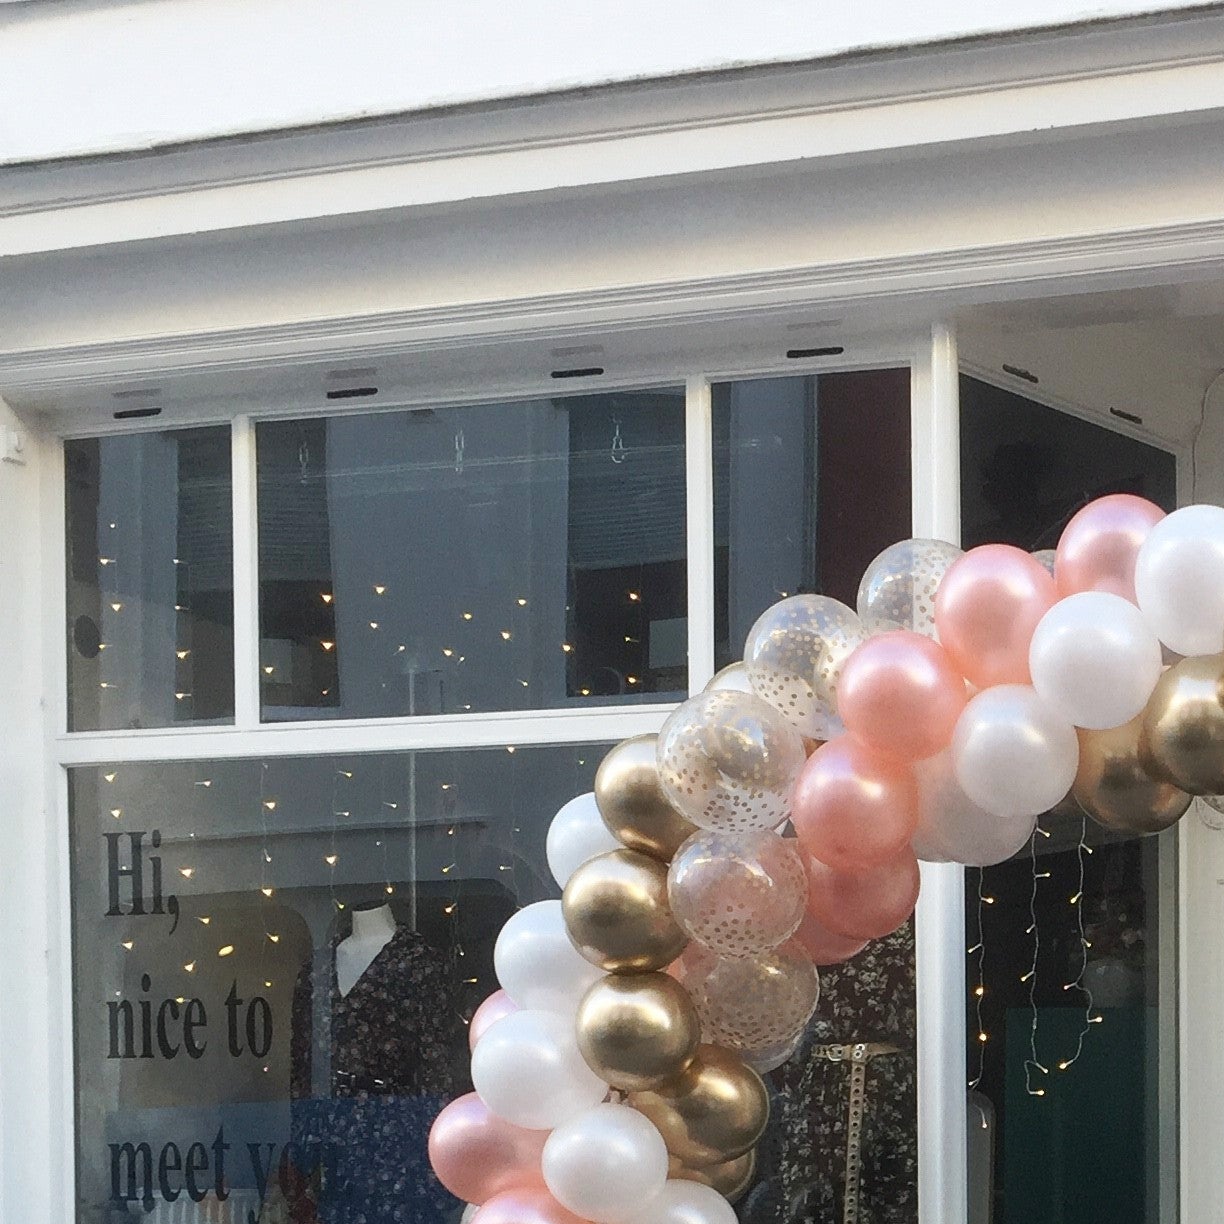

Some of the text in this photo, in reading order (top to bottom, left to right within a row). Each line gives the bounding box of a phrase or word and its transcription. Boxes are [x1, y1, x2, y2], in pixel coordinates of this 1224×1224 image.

[103, 829, 180, 934] Hi,
[106, 973, 274, 1060] nice to
[107, 1121, 231, 1203] meet
